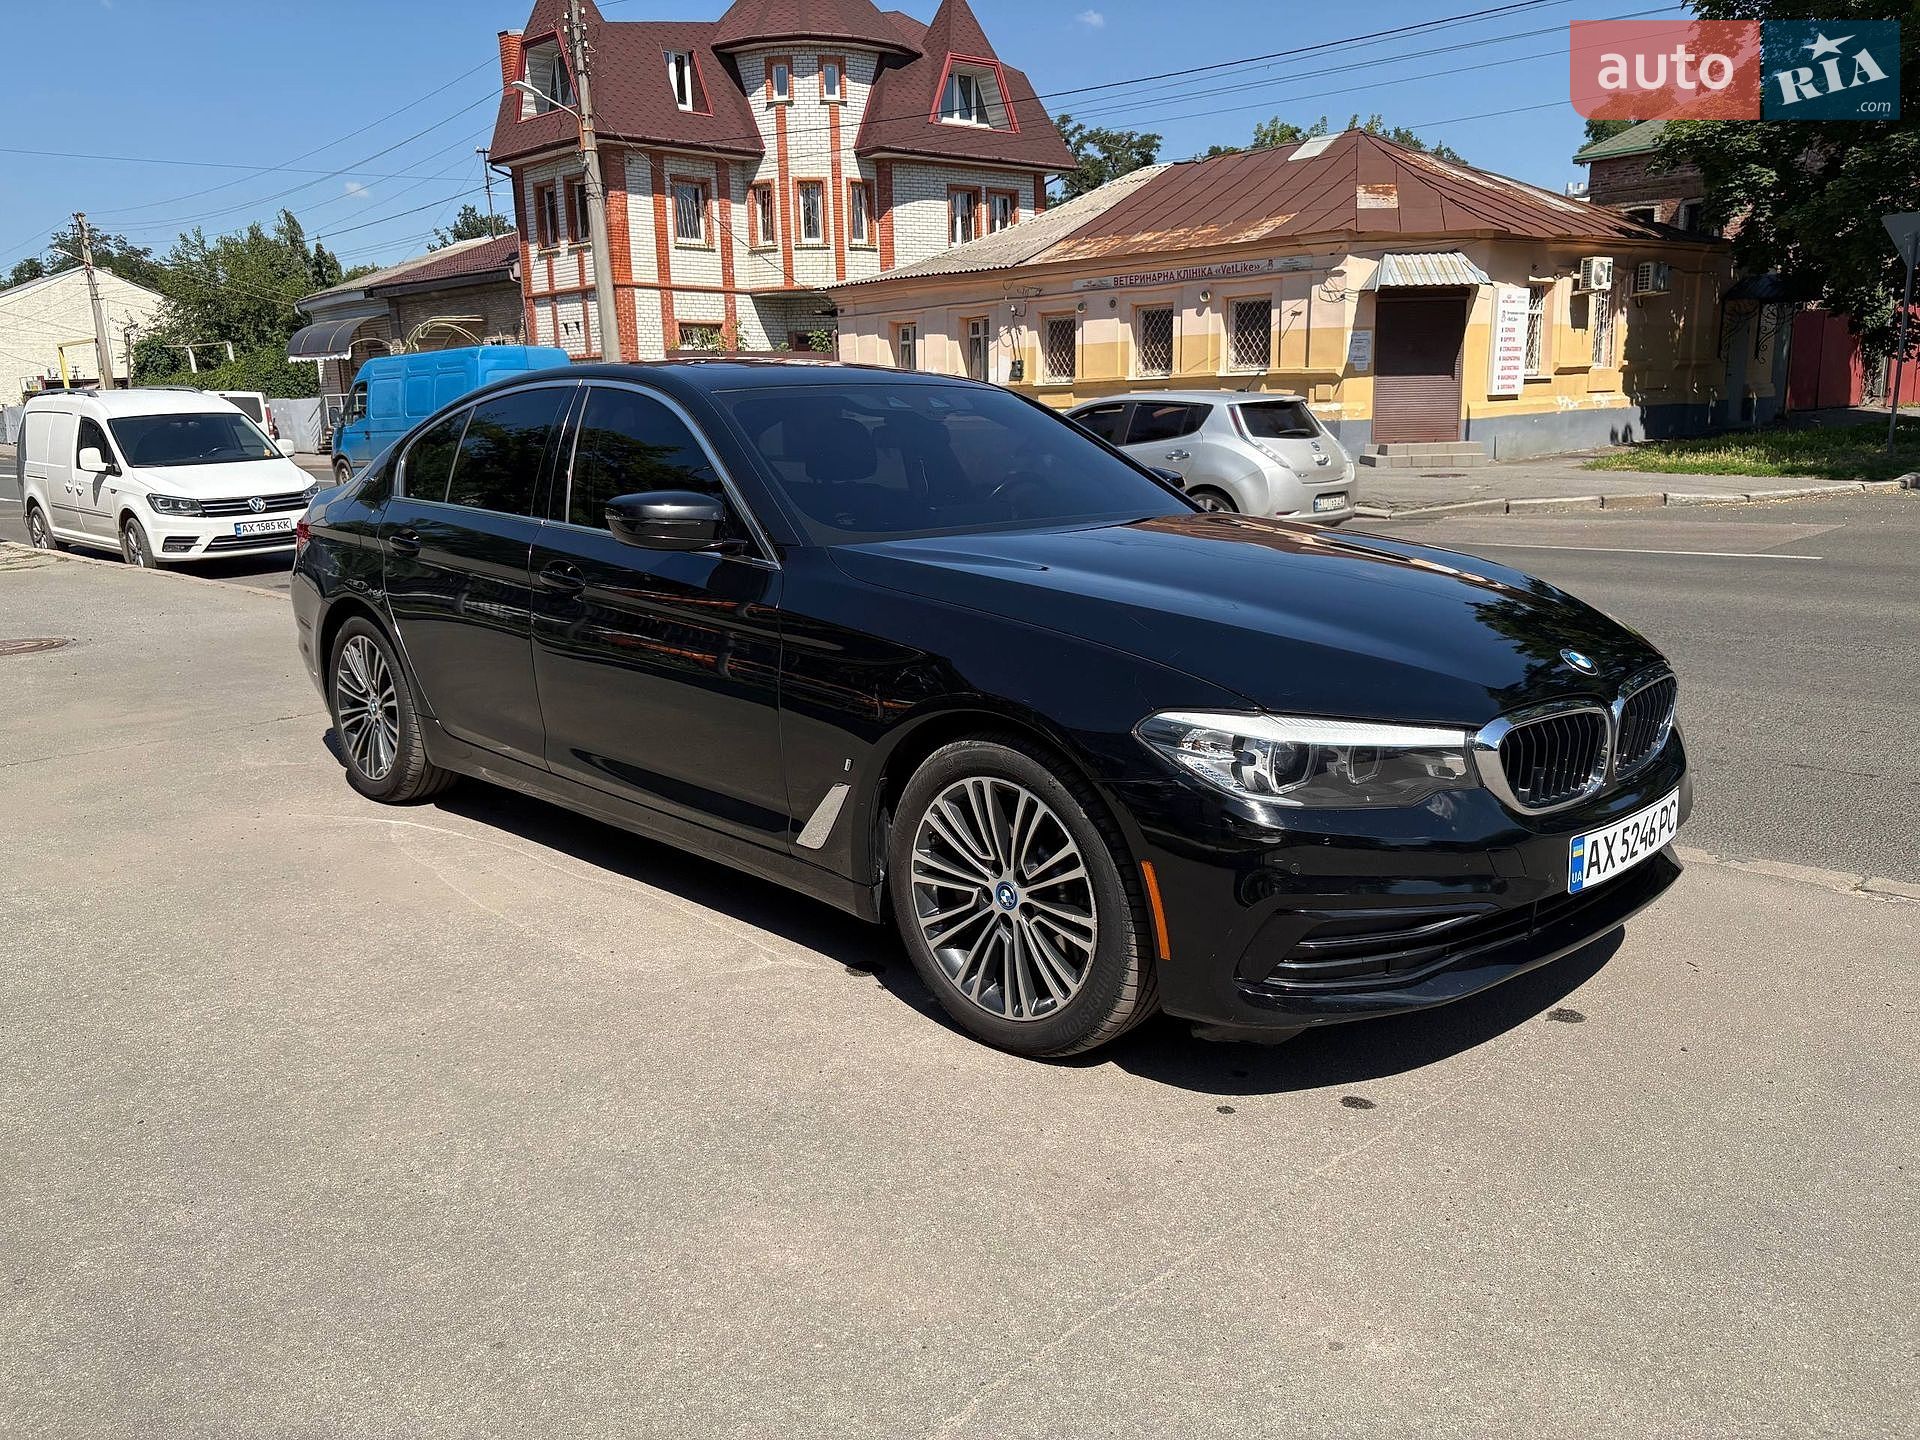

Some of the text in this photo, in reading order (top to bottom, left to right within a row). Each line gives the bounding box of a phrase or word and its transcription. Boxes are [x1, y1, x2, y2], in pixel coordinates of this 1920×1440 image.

[1113, 270, 1174, 286] ВЕТЕРИНАРНА
[1176, 266, 1213, 280] КЛІНІКА
[242, 520, 290, 533] AX 1585 KK
[1586, 799, 1676, 879] AX 5246 PC
[1572, 872, 1583, 883] UA
